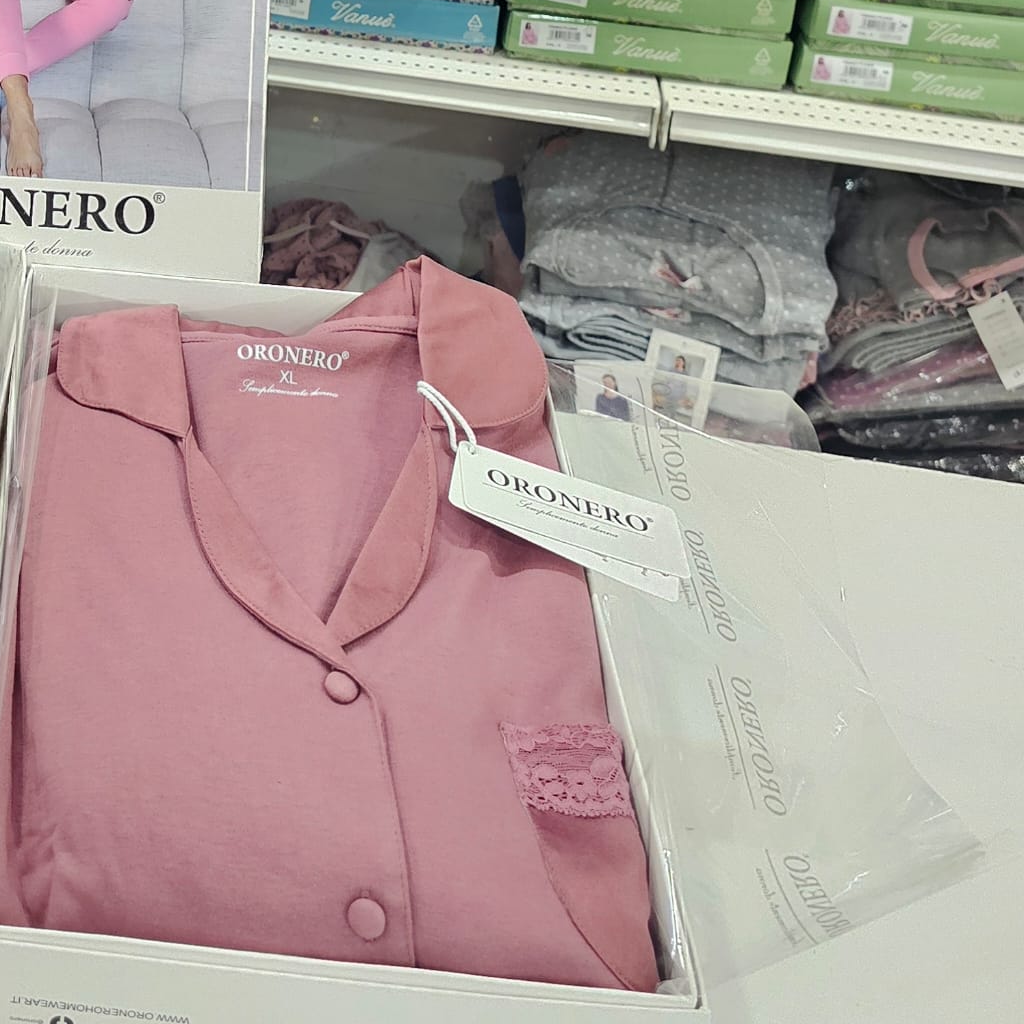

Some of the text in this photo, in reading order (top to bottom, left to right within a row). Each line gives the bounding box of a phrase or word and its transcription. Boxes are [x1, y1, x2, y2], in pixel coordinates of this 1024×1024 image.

[331, 1, 395, 28] Vanuè
[613, 35, 682, 64] Vanuè
[928, 22, 998, 50] Vanuè
[912, 72, 983, 101] Vanuè
[43, 239, 93, 257] donna
[280, 370, 297, 385] XL
